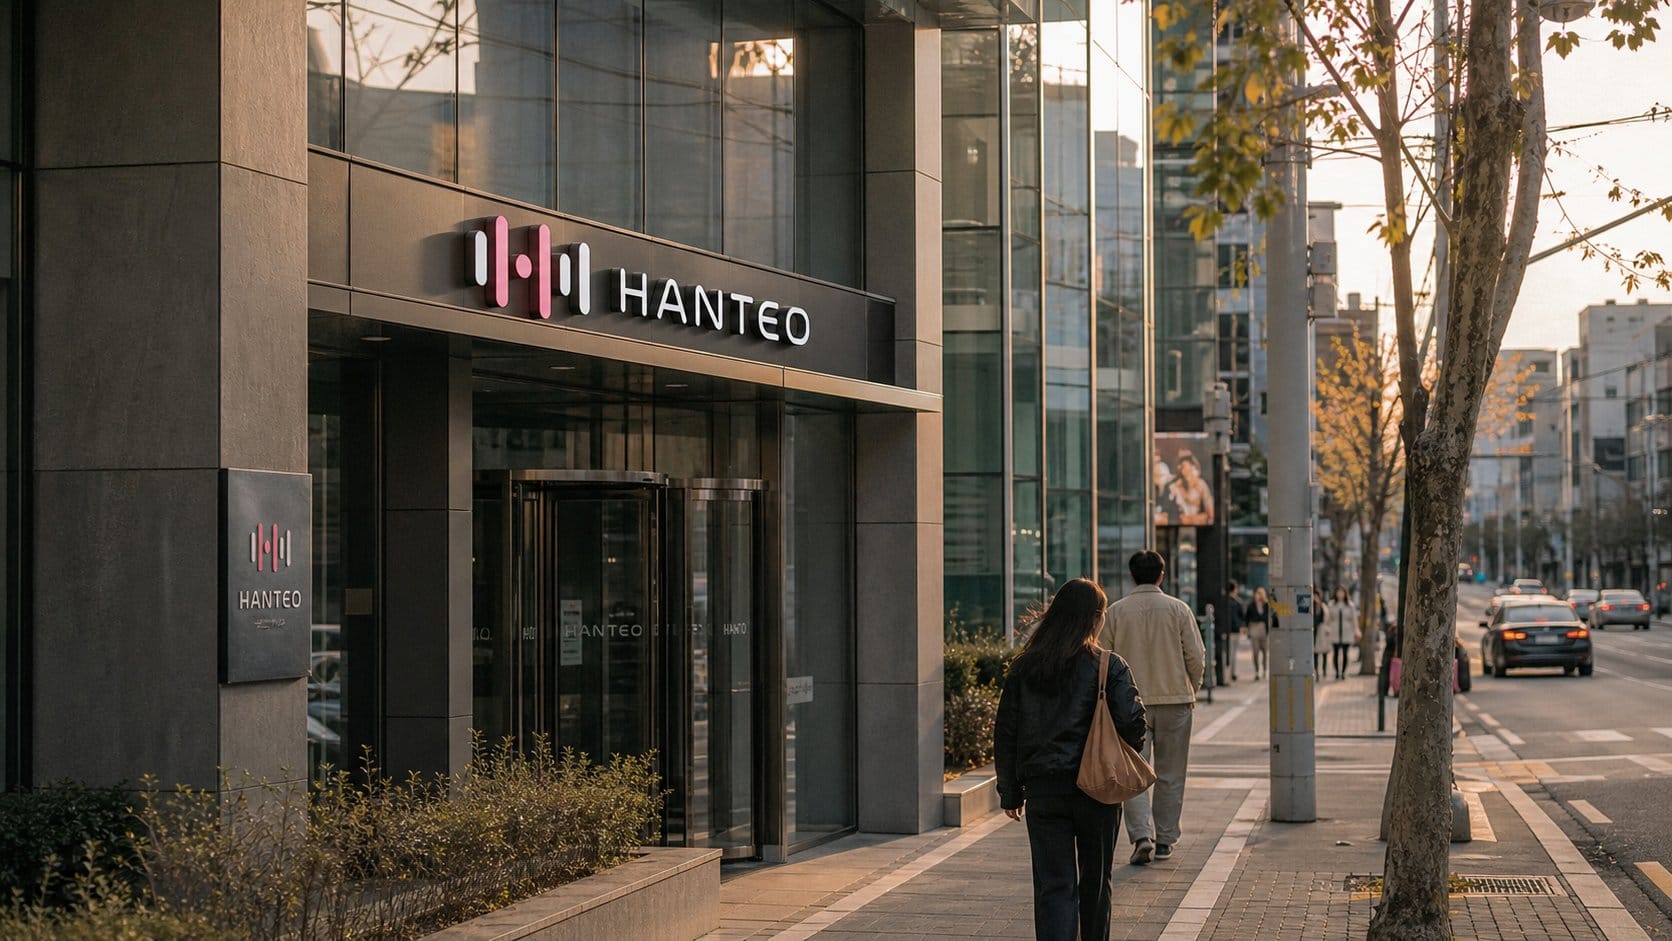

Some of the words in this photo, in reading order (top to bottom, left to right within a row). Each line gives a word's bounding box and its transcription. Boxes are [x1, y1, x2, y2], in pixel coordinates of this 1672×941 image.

[619, 267, 810, 346] HANTEO
[239, 590, 302, 610] HANTEO
[564, 624, 643, 638] HANTEO
